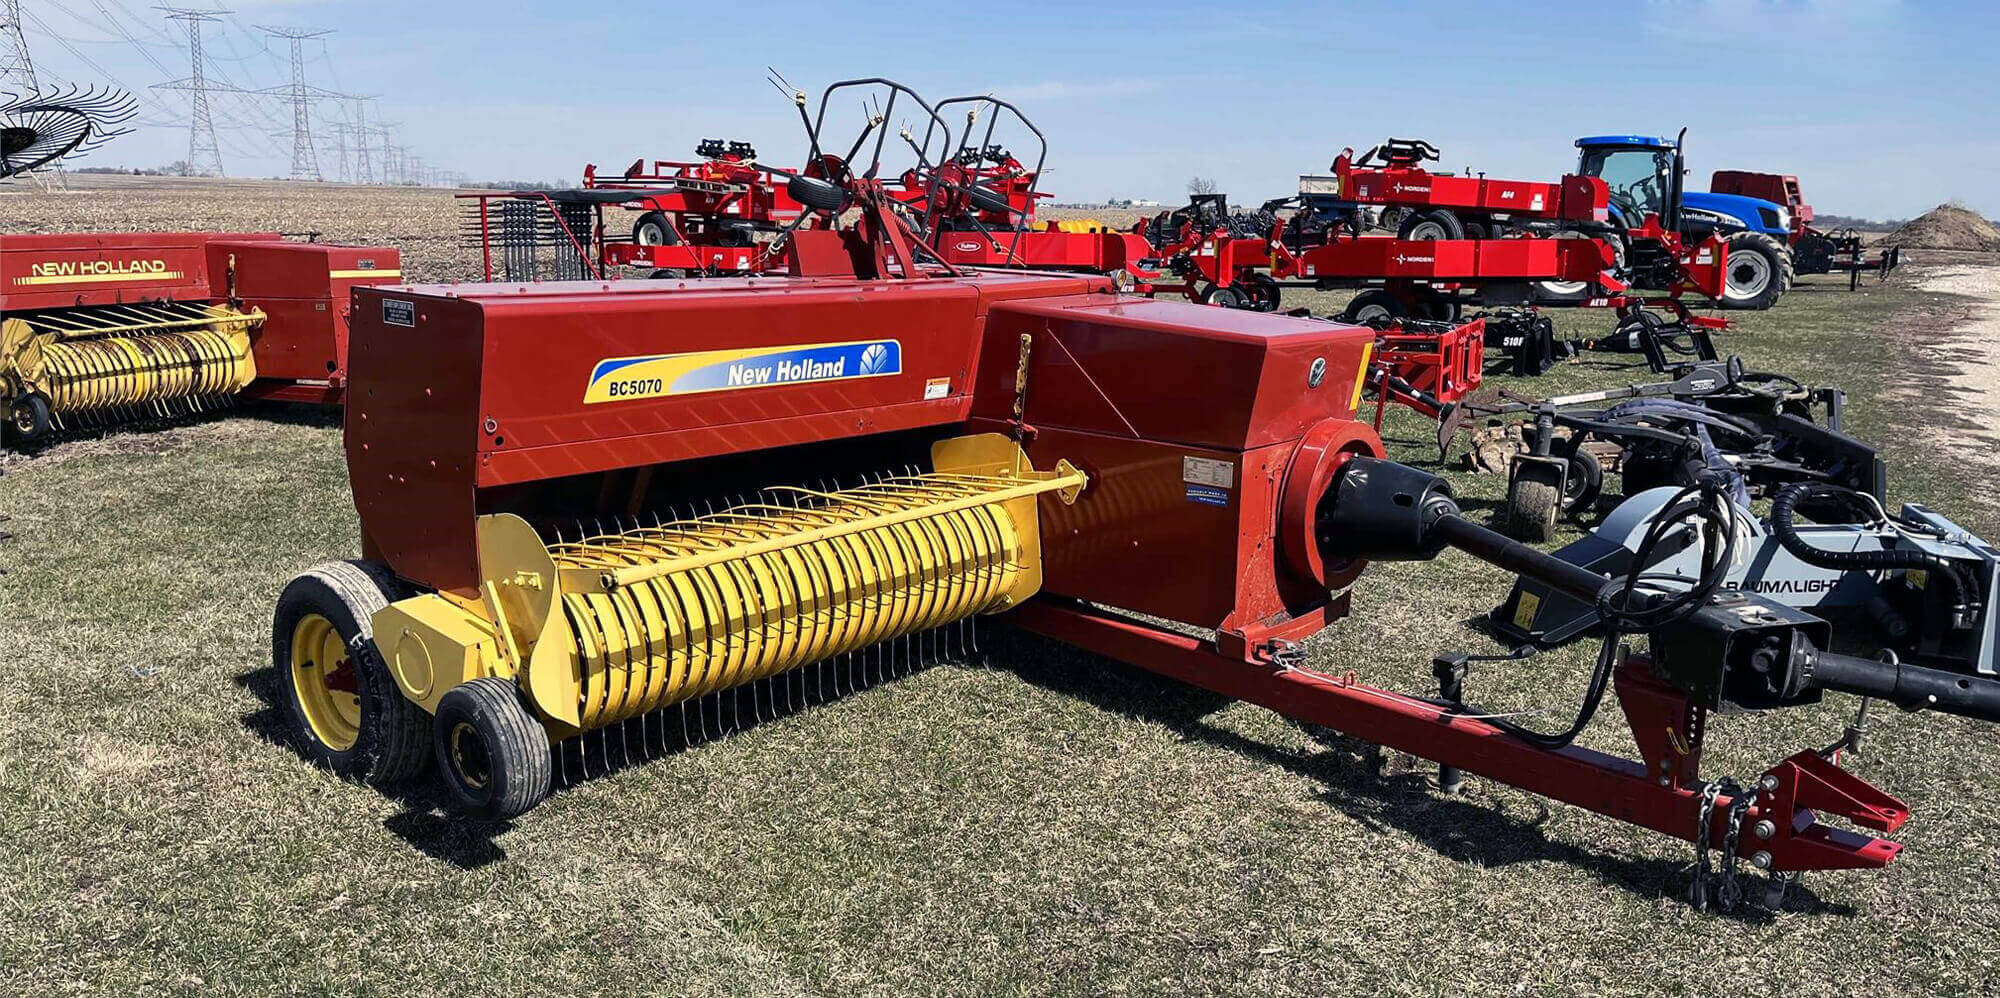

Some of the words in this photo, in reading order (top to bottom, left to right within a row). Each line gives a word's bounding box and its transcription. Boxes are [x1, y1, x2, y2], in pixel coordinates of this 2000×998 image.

[31, 262, 76, 276] NEW
[80, 260, 165, 274] HOLLAND
[609, 378, 663, 396] BC5070
[728, 364, 772, 386] New
[776, 356, 845, 382] Holland
